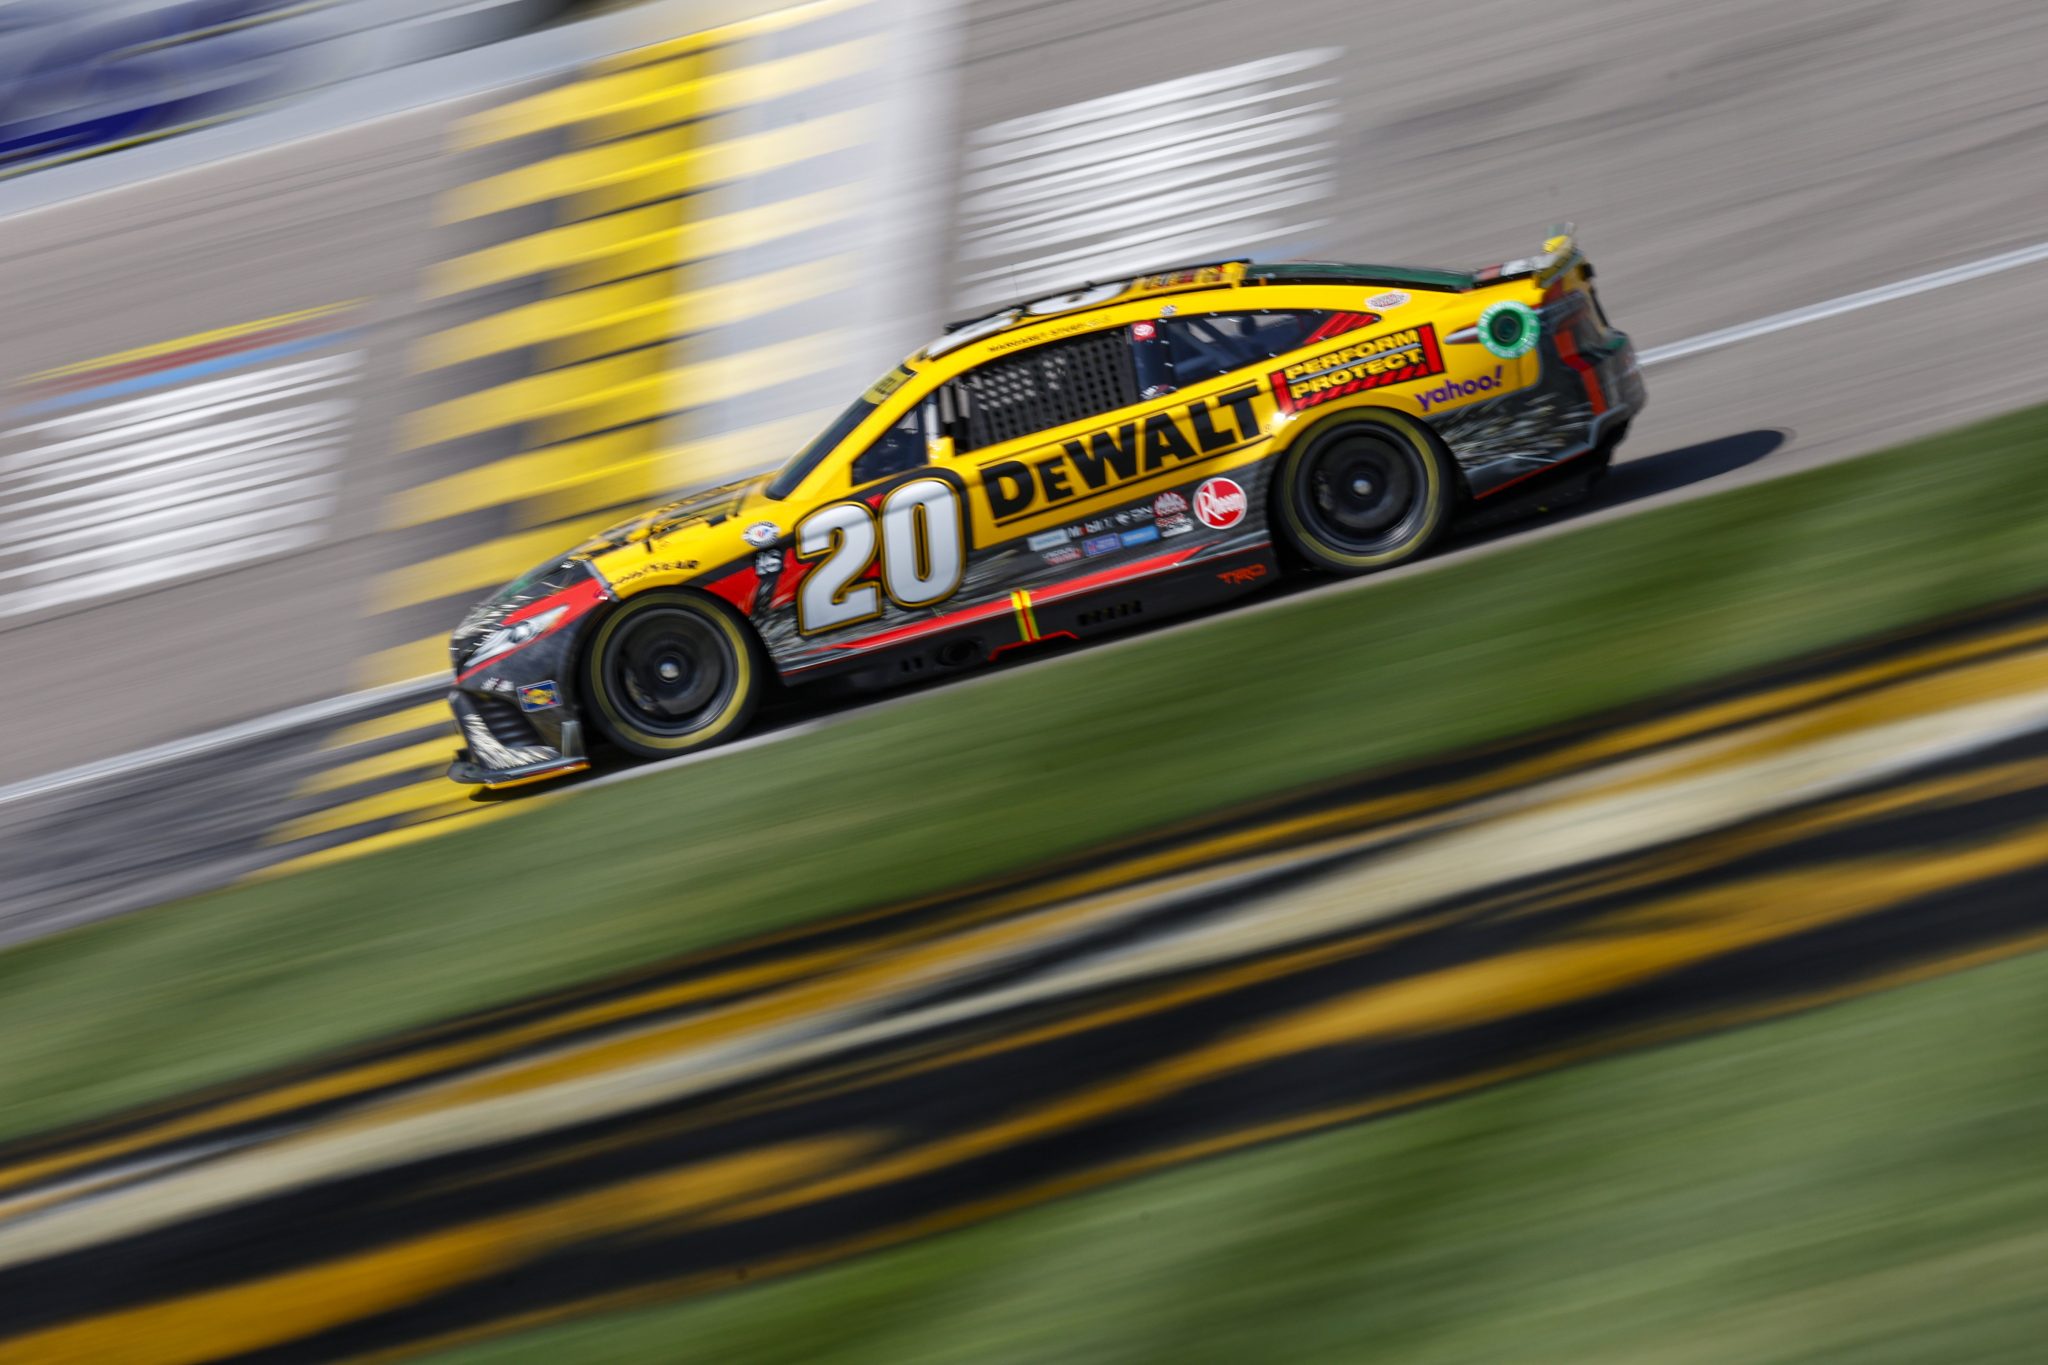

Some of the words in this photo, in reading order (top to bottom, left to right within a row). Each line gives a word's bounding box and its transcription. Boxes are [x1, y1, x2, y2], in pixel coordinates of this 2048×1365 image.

[1284, 329, 1420, 380] PERFORM
[1290, 347, 1424, 399] PROTECT
[1415, 365, 1504, 411] yahoo!
[795, 477, 967, 637] 20
